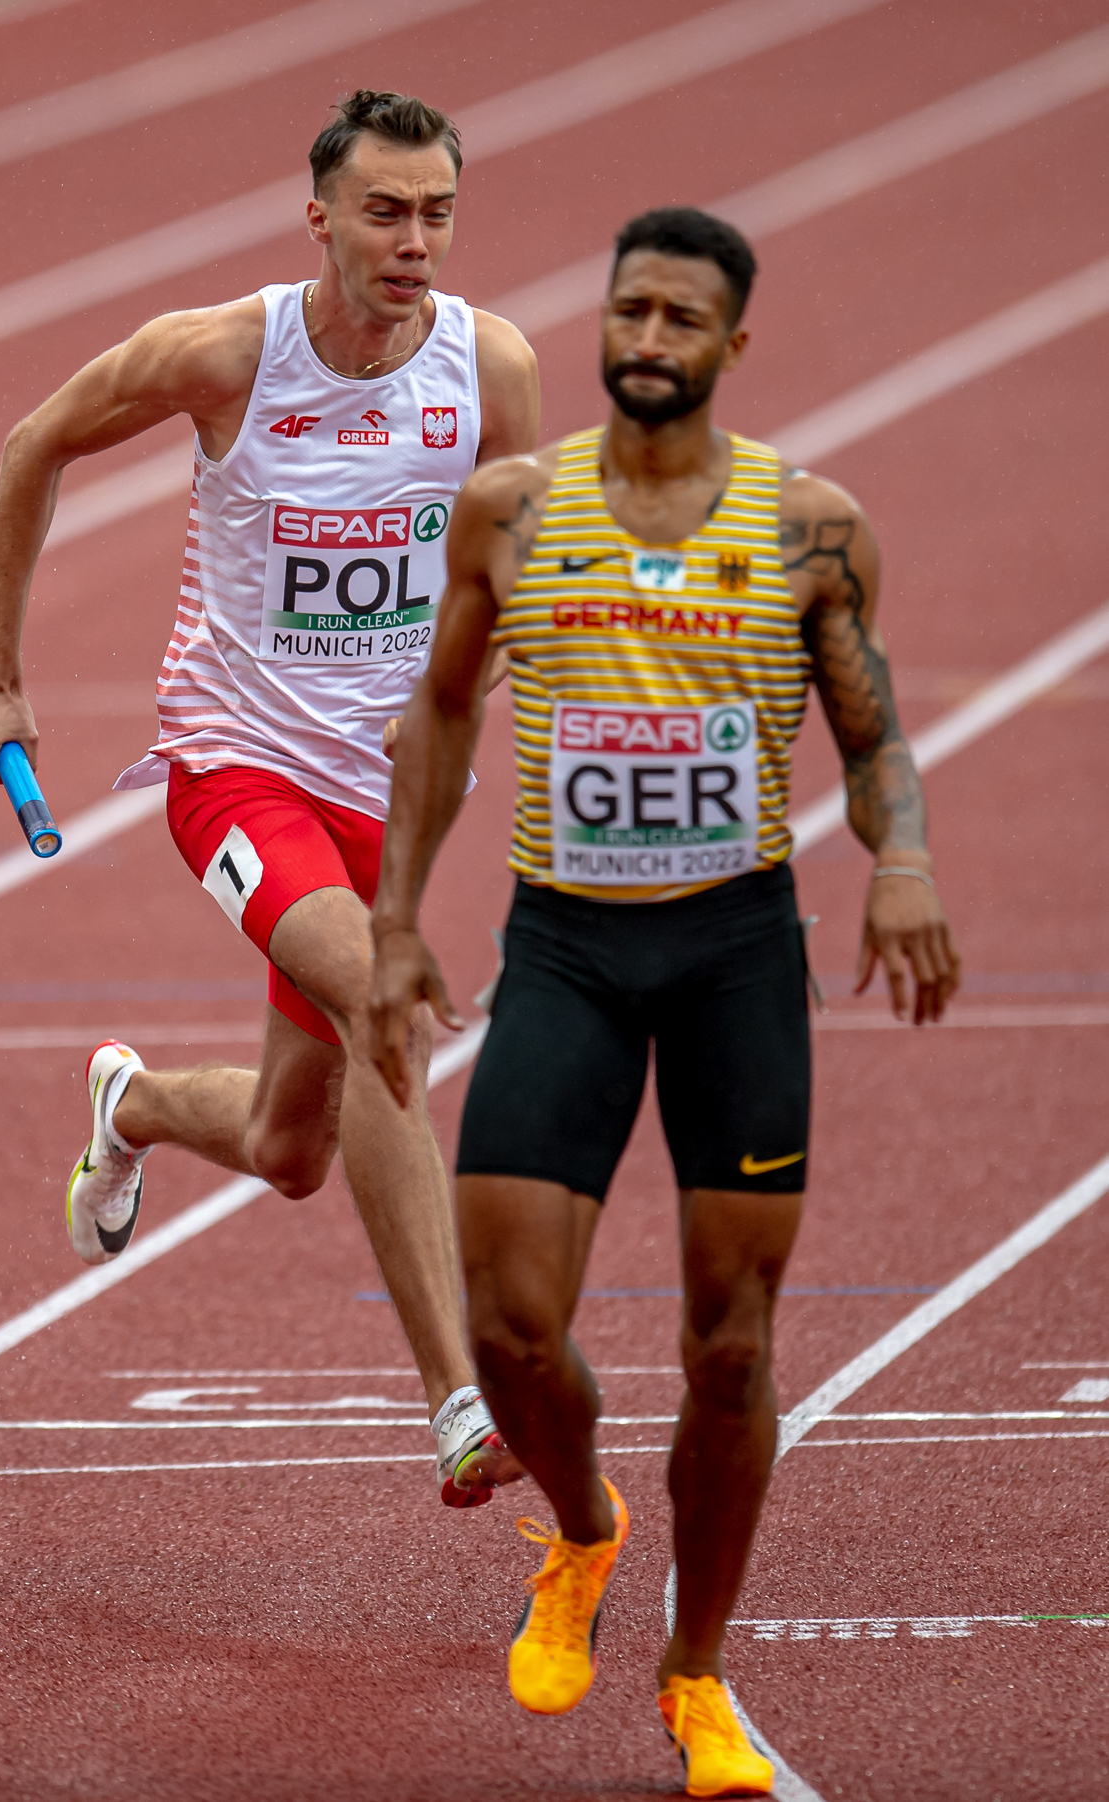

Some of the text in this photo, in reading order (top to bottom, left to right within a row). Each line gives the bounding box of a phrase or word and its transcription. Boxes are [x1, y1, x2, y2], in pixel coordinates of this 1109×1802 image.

[269, 414, 322, 438] 4F
[340, 431, 386, 444] ORLEN
[277, 511, 408, 544] SPAR
[283, 554, 431, 616] POL
[307, 615, 313, 629] I
[317, 615, 352, 629] RUN
[552, 601, 746, 639] GERMANY
[273, 626, 431, 657] MUNICH 2022
[562, 712, 698, 750] SPAR
[566, 765, 742, 828] GER
[218, 849, 246, 897] 1
[564, 847, 747, 877] MUNICH 2022
